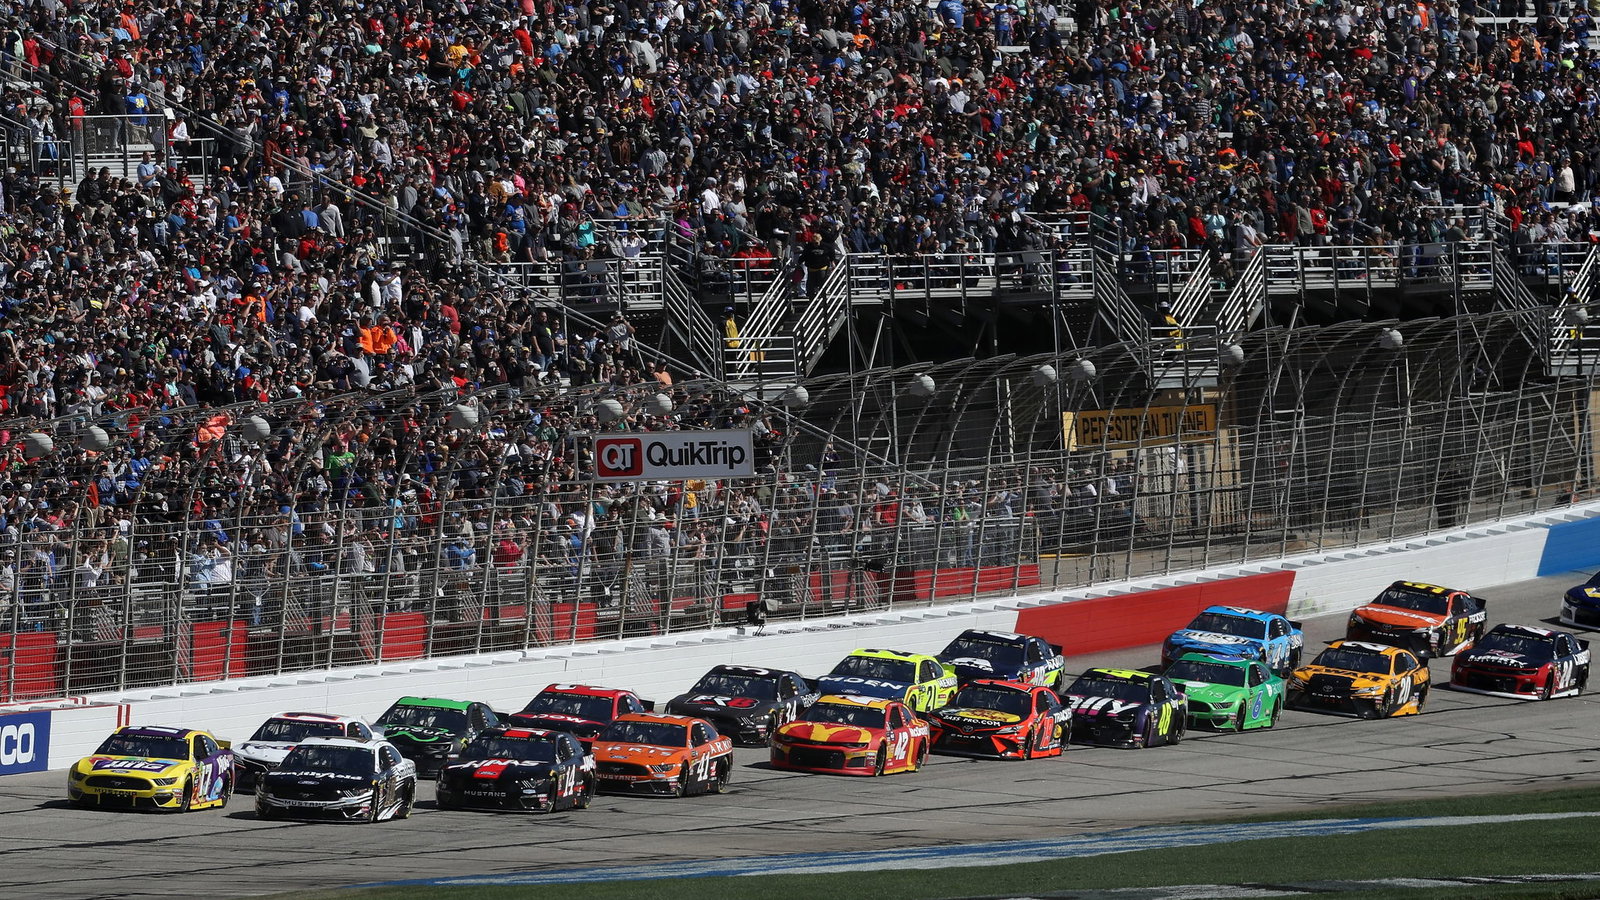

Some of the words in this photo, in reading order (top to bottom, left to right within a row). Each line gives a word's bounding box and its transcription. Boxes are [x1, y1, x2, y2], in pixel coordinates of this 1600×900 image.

[602, 443, 635, 471] QT
[646, 441, 746, 470] QuikTrip
[818, 677, 904, 691] MOEN
[1397, 676, 1412, 704] 20
[894, 731, 908, 760] 42
[198, 761, 213, 797] 17
[595, 773, 637, 781] MUSTANG
[697, 751, 710, 782] 41
[94, 787, 137, 796] MUSTANG
[562, 764, 576, 798] 14
[284, 799, 328, 808] MUSTANG
